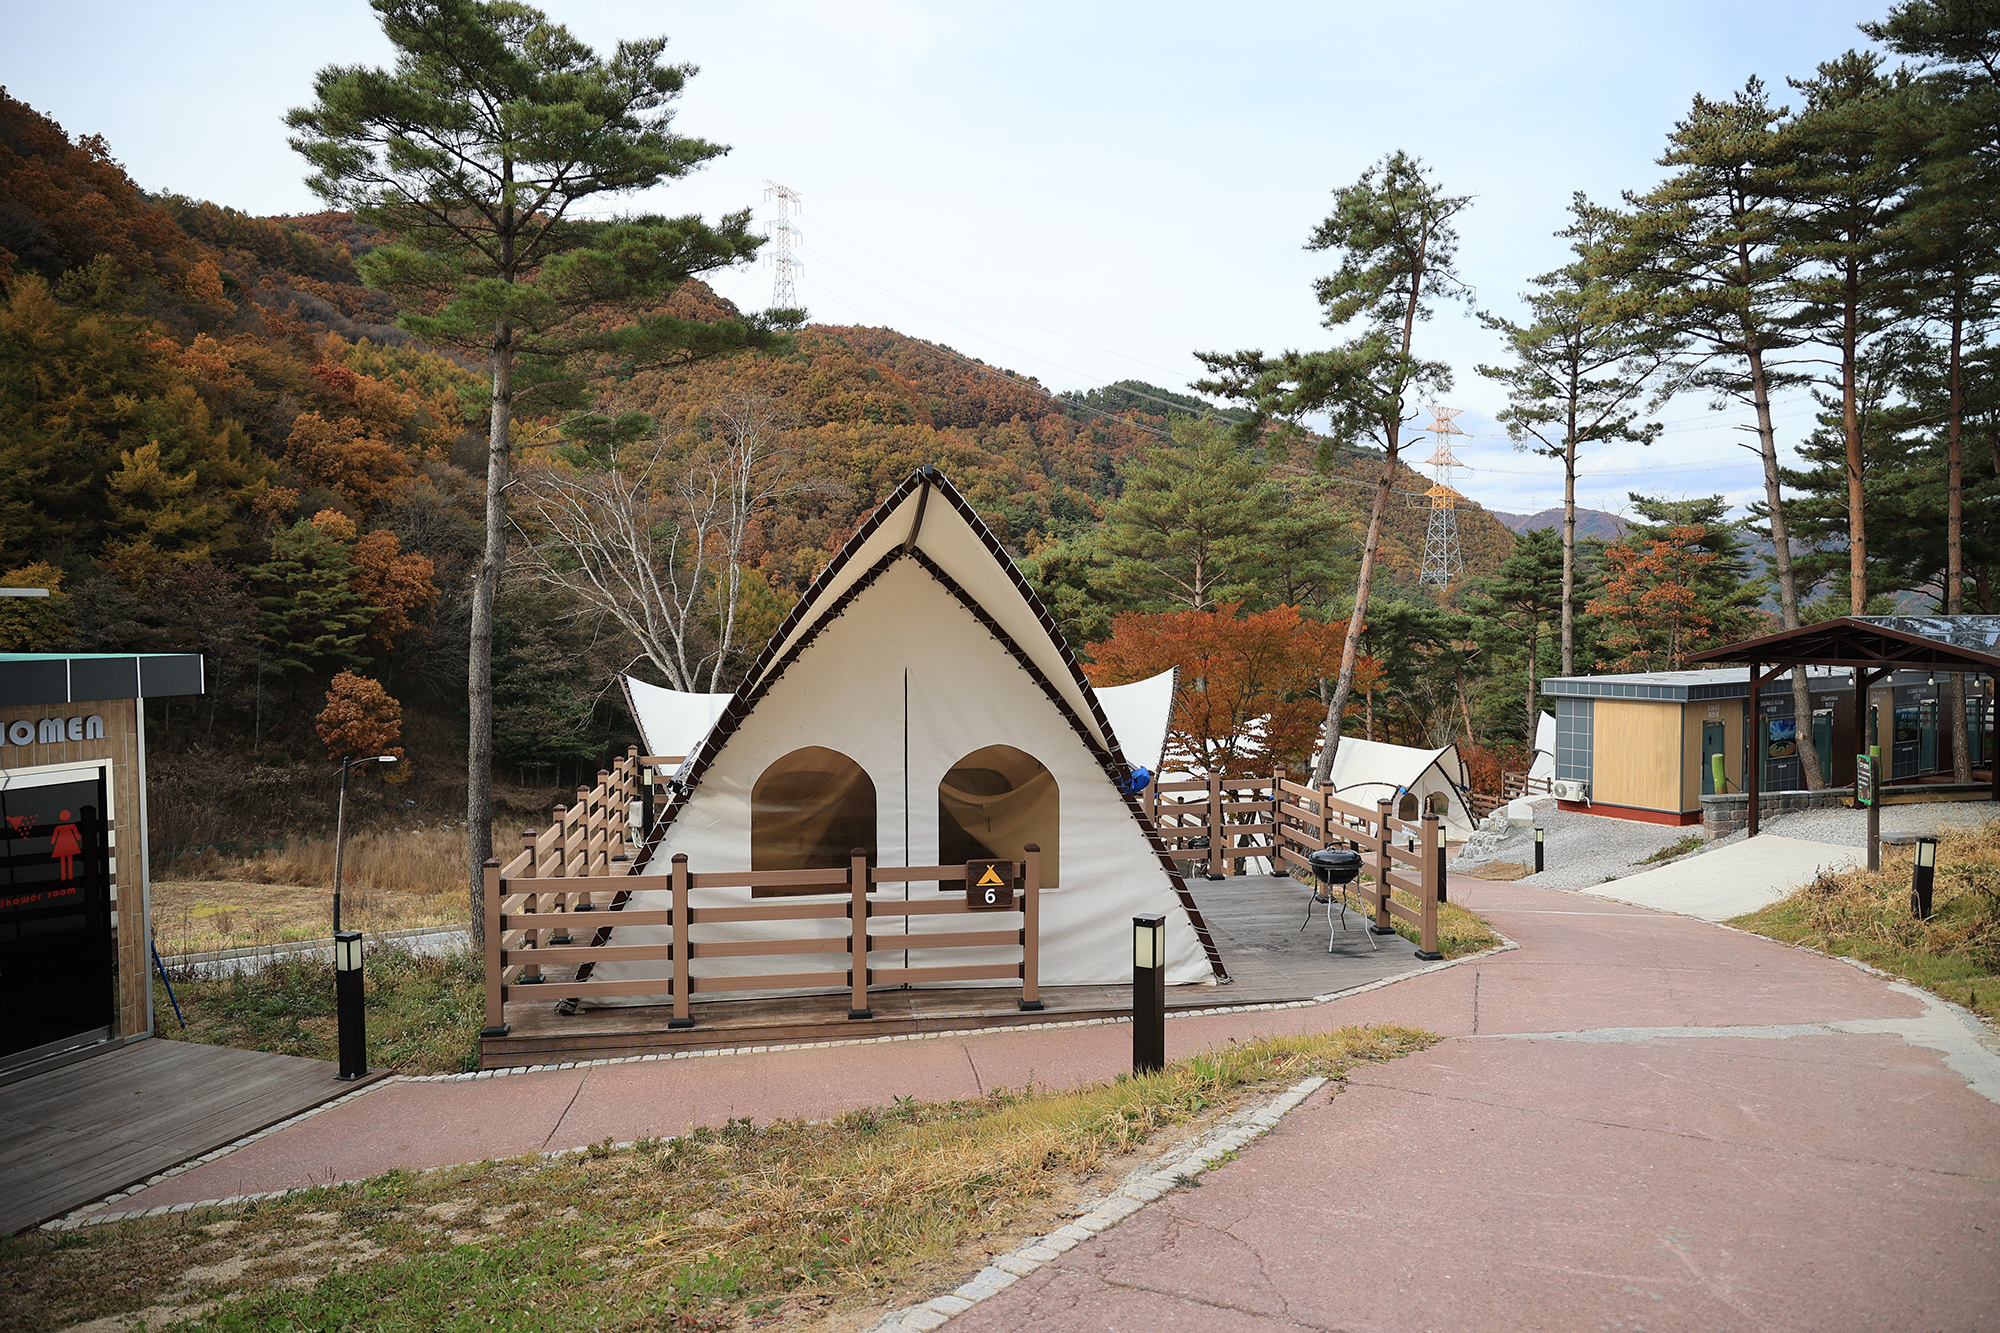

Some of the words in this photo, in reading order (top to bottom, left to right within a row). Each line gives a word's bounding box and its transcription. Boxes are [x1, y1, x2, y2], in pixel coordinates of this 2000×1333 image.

[0, 715, 104, 747] OMEN
[47, 887, 76, 899] room
[984, 888, 997, 904] 6
